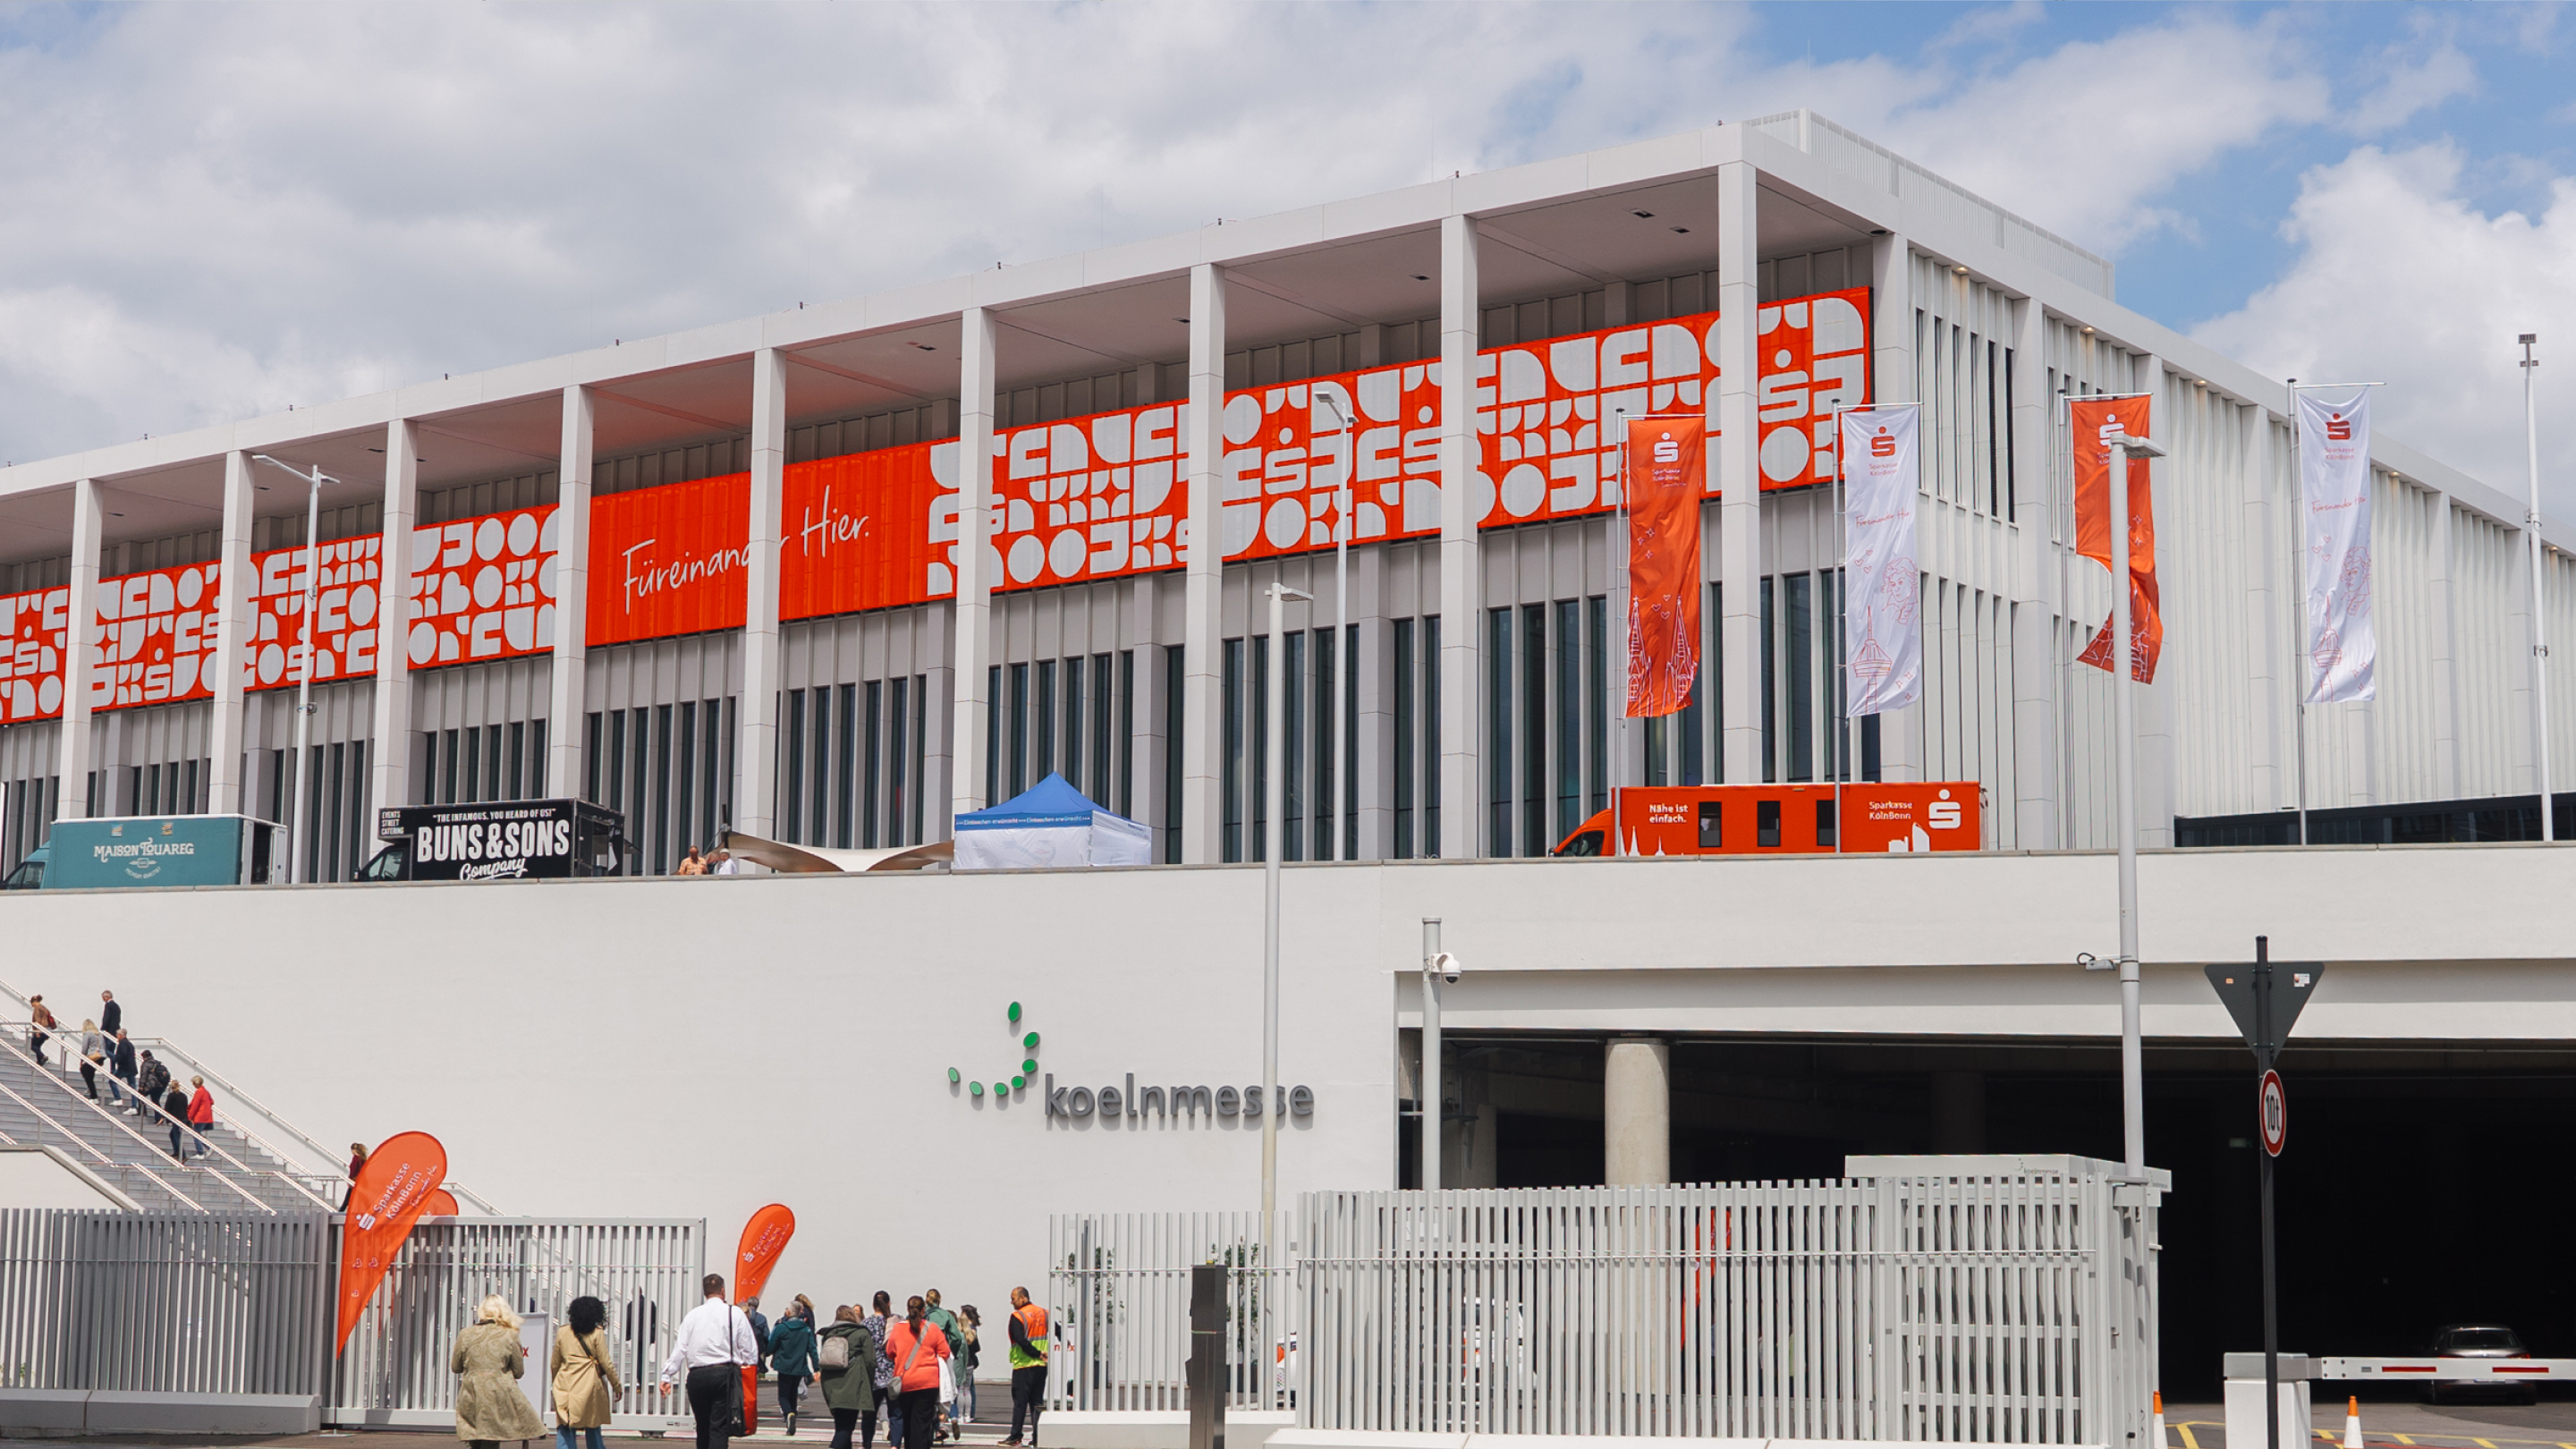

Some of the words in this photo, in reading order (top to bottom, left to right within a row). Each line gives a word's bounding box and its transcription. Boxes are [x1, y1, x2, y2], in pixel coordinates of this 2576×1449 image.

[621, 535, 791, 615] Füreinan
[801, 484, 869, 559] Hier.
[1648, 803, 1674, 813] Nähe
[1675, 803, 1689, 813] ist
[1868, 800, 1913, 810] Sparkasse
[382, 810, 402, 819] EVENTS
[489, 810, 504, 820] YOU
[505, 809, 529, 819] HEARD
[530, 809, 539, 818] OF
[1648, 813, 1687, 824] einfach.
[1868, 811, 1911, 820] KölnBonn
[381, 818, 401, 827] STREET
[381, 826, 404, 835] CATERING
[93, 844, 140, 863] MAISON
[139, 836, 195, 856] TOUAREG
[459, 857, 529, 881] Company
[373, 1162, 411, 1213] Sparkasse
[385, 1171, 422, 1220] KölnBonn
